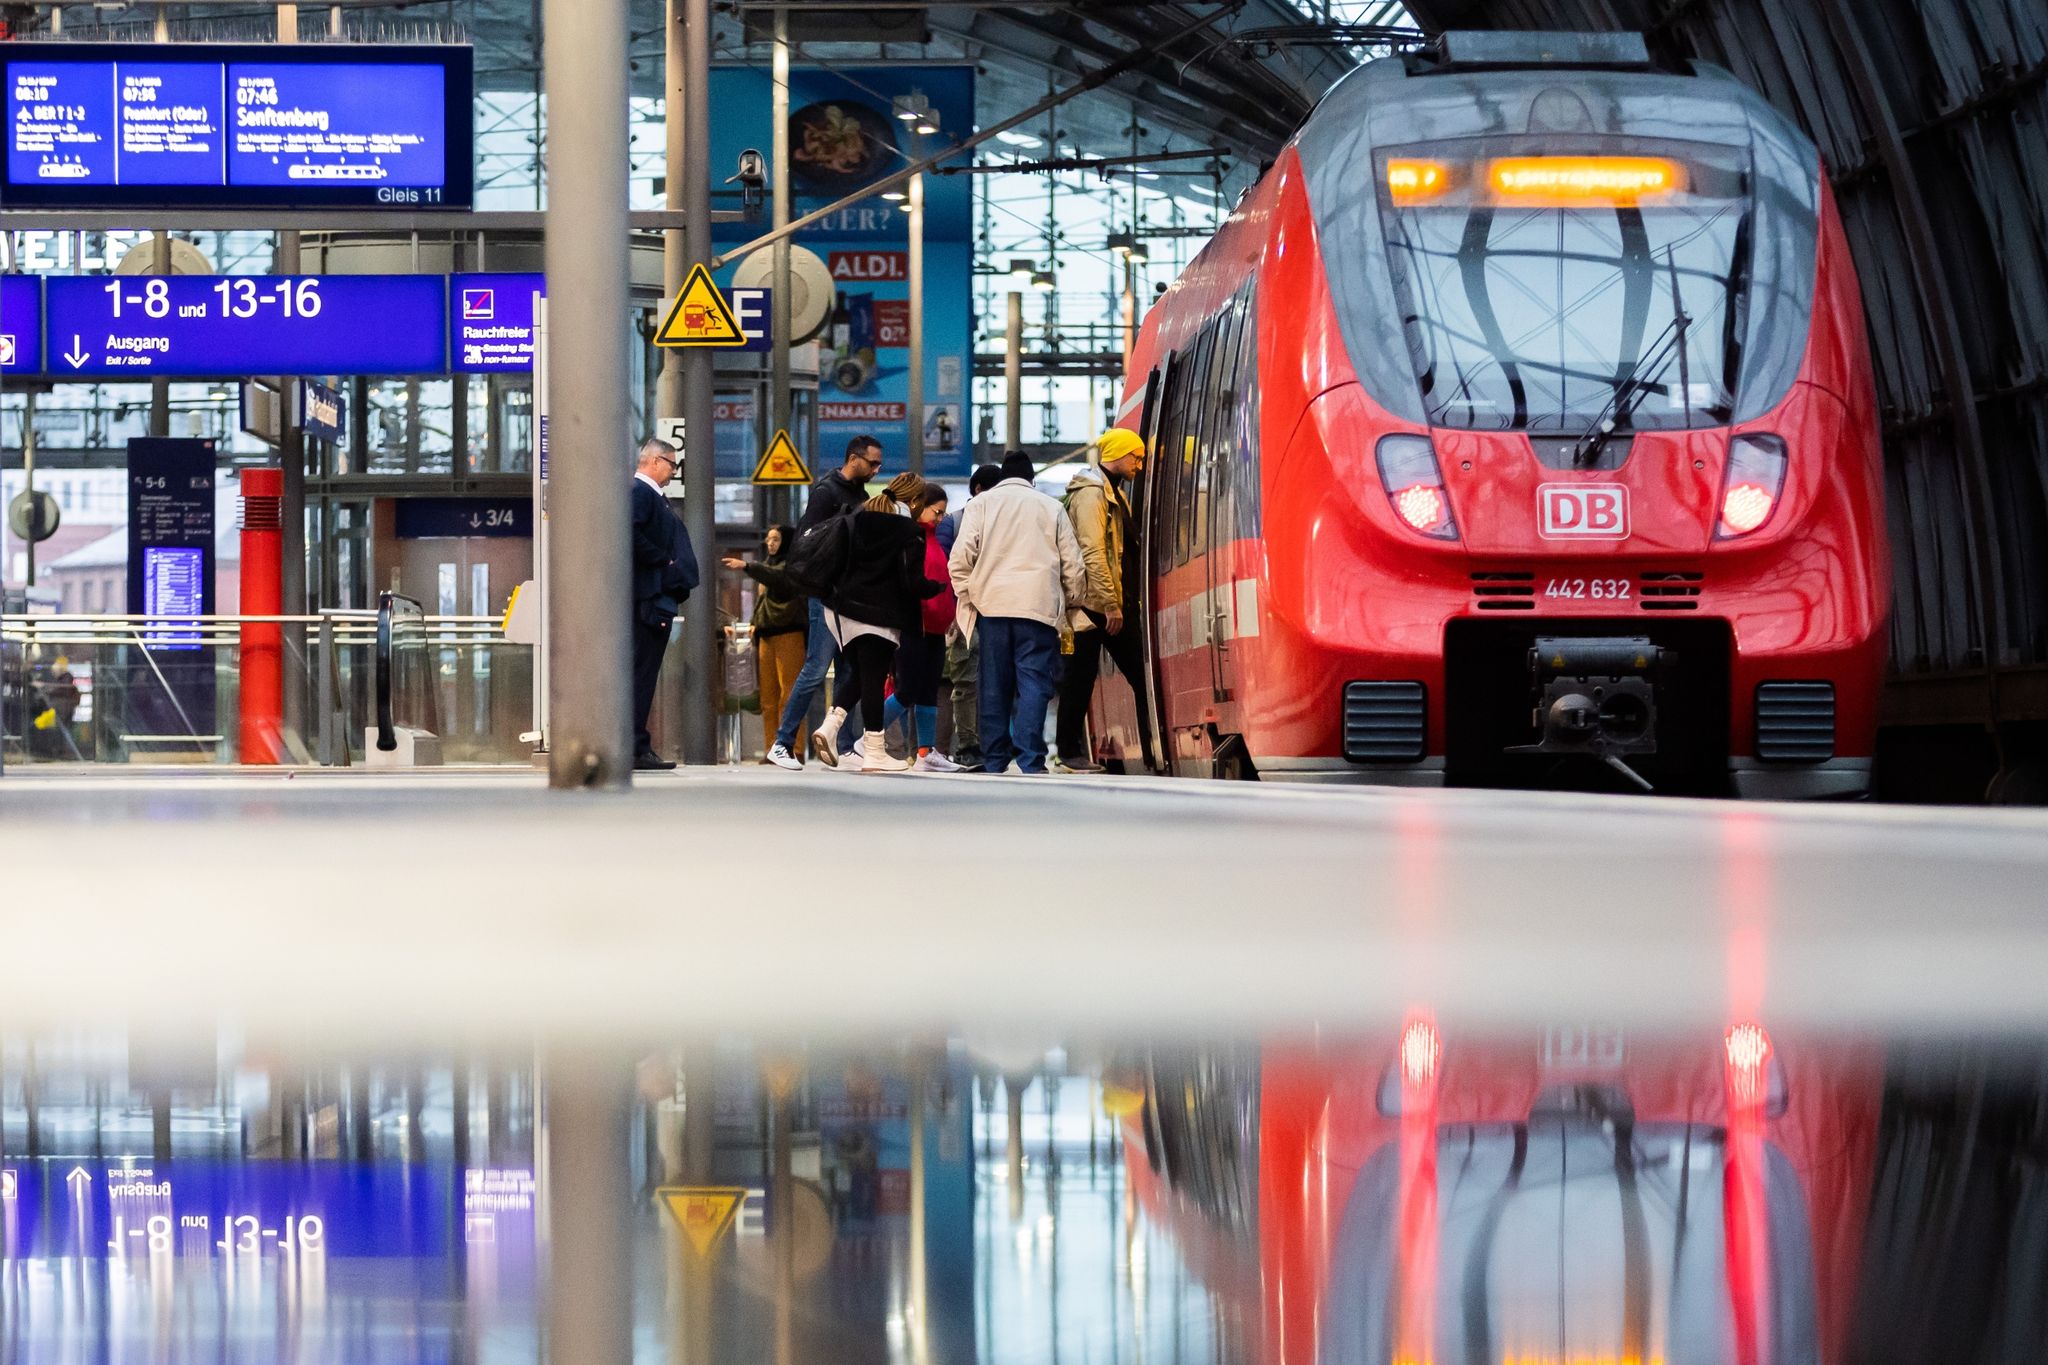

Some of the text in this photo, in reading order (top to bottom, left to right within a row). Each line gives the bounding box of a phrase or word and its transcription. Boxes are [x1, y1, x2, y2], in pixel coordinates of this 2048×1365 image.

[237, 87, 278, 105] 07:46
[172, 105, 208, 122] (Oder)
[237, 106, 330, 131] Senftenberg
[377, 187, 441, 203] Gleis 11
[833, 255, 903, 277] ALDI.
[104, 278, 322, 318] 1-8 und 13-16
[733, 290, 764, 338] E
[463, 325, 531, 339] Rauchfreier
[106, 334, 170, 353] Ausgang
[106, 355, 122, 365] Exit
[127, 355, 152, 366] Sortie
[671, 425, 686, 452] 5
[145, 476, 166, 489] 5-6
[485, 509, 514, 526] 3/4
[1550, 493, 1619, 530] DB
[1544, 578, 1631, 599] 442 632
